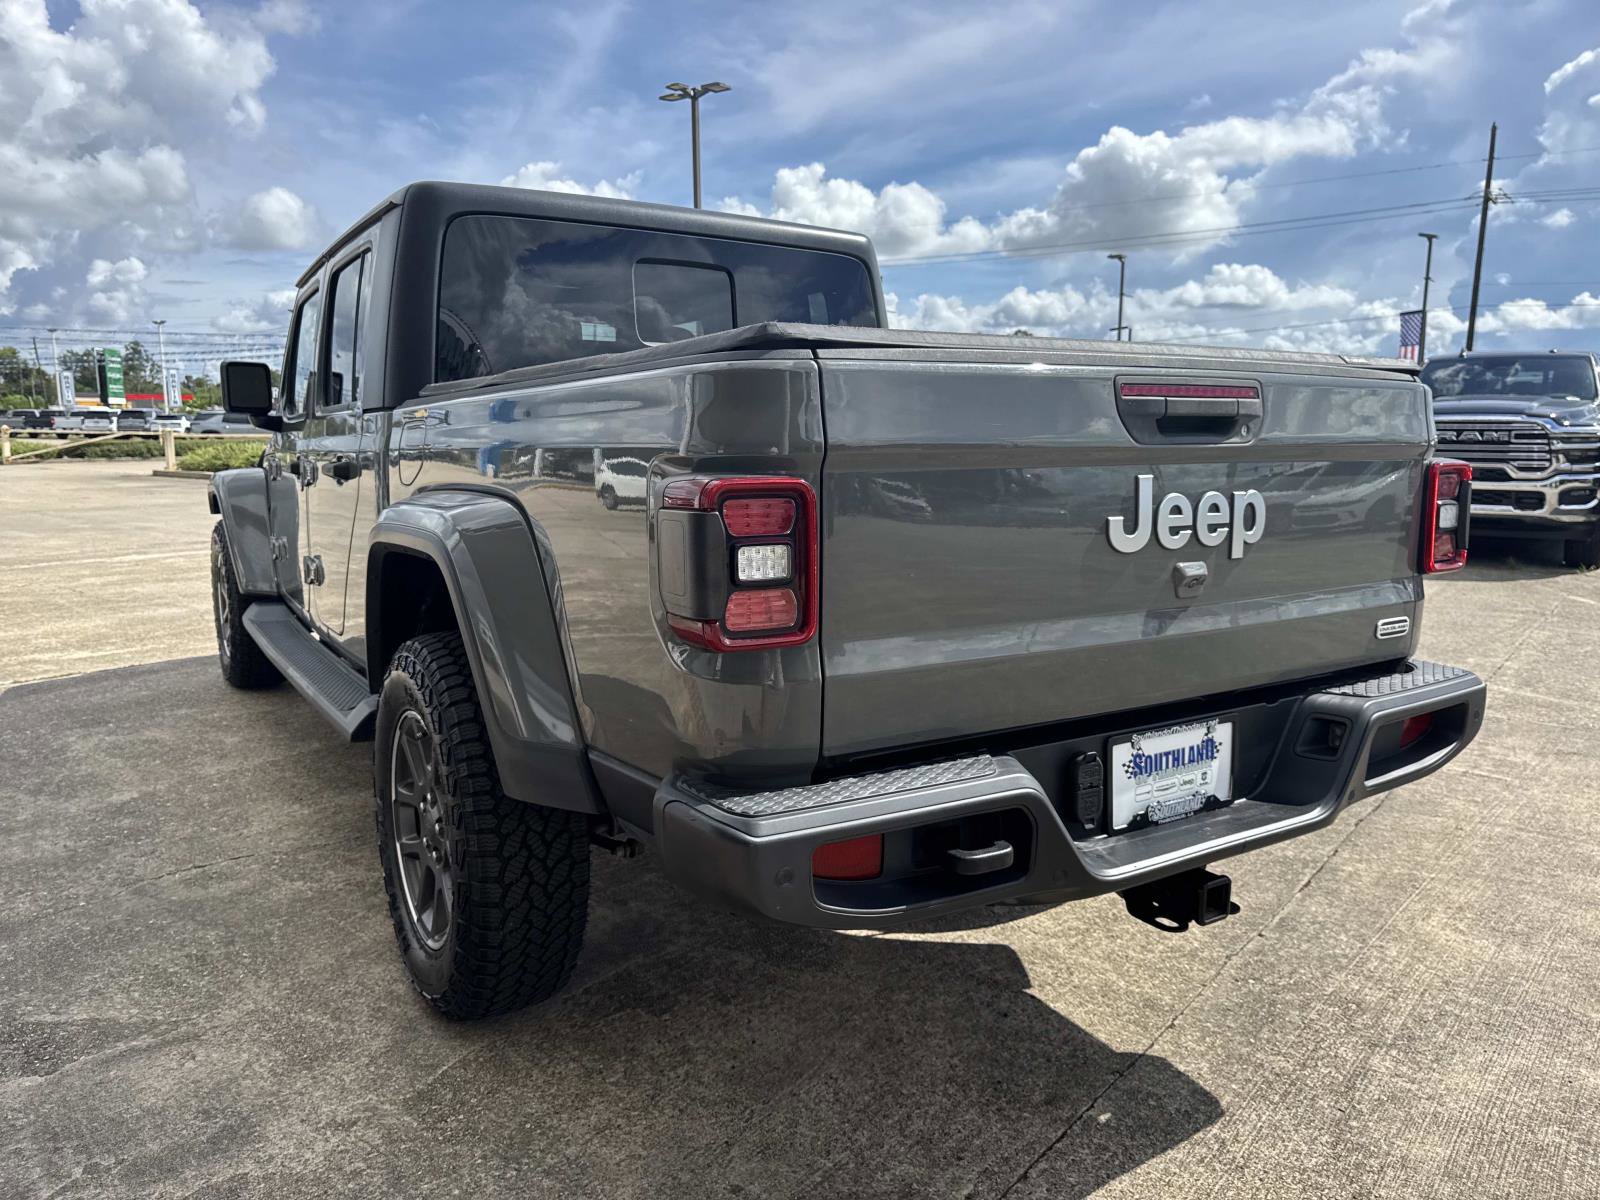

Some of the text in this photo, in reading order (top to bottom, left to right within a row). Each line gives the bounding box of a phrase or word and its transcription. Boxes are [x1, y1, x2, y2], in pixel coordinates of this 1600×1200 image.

[1437, 430, 1510, 442] RAM
[1107, 474, 1266, 560] Jeep
[1132, 736, 1217, 779] SOUTHLAND
